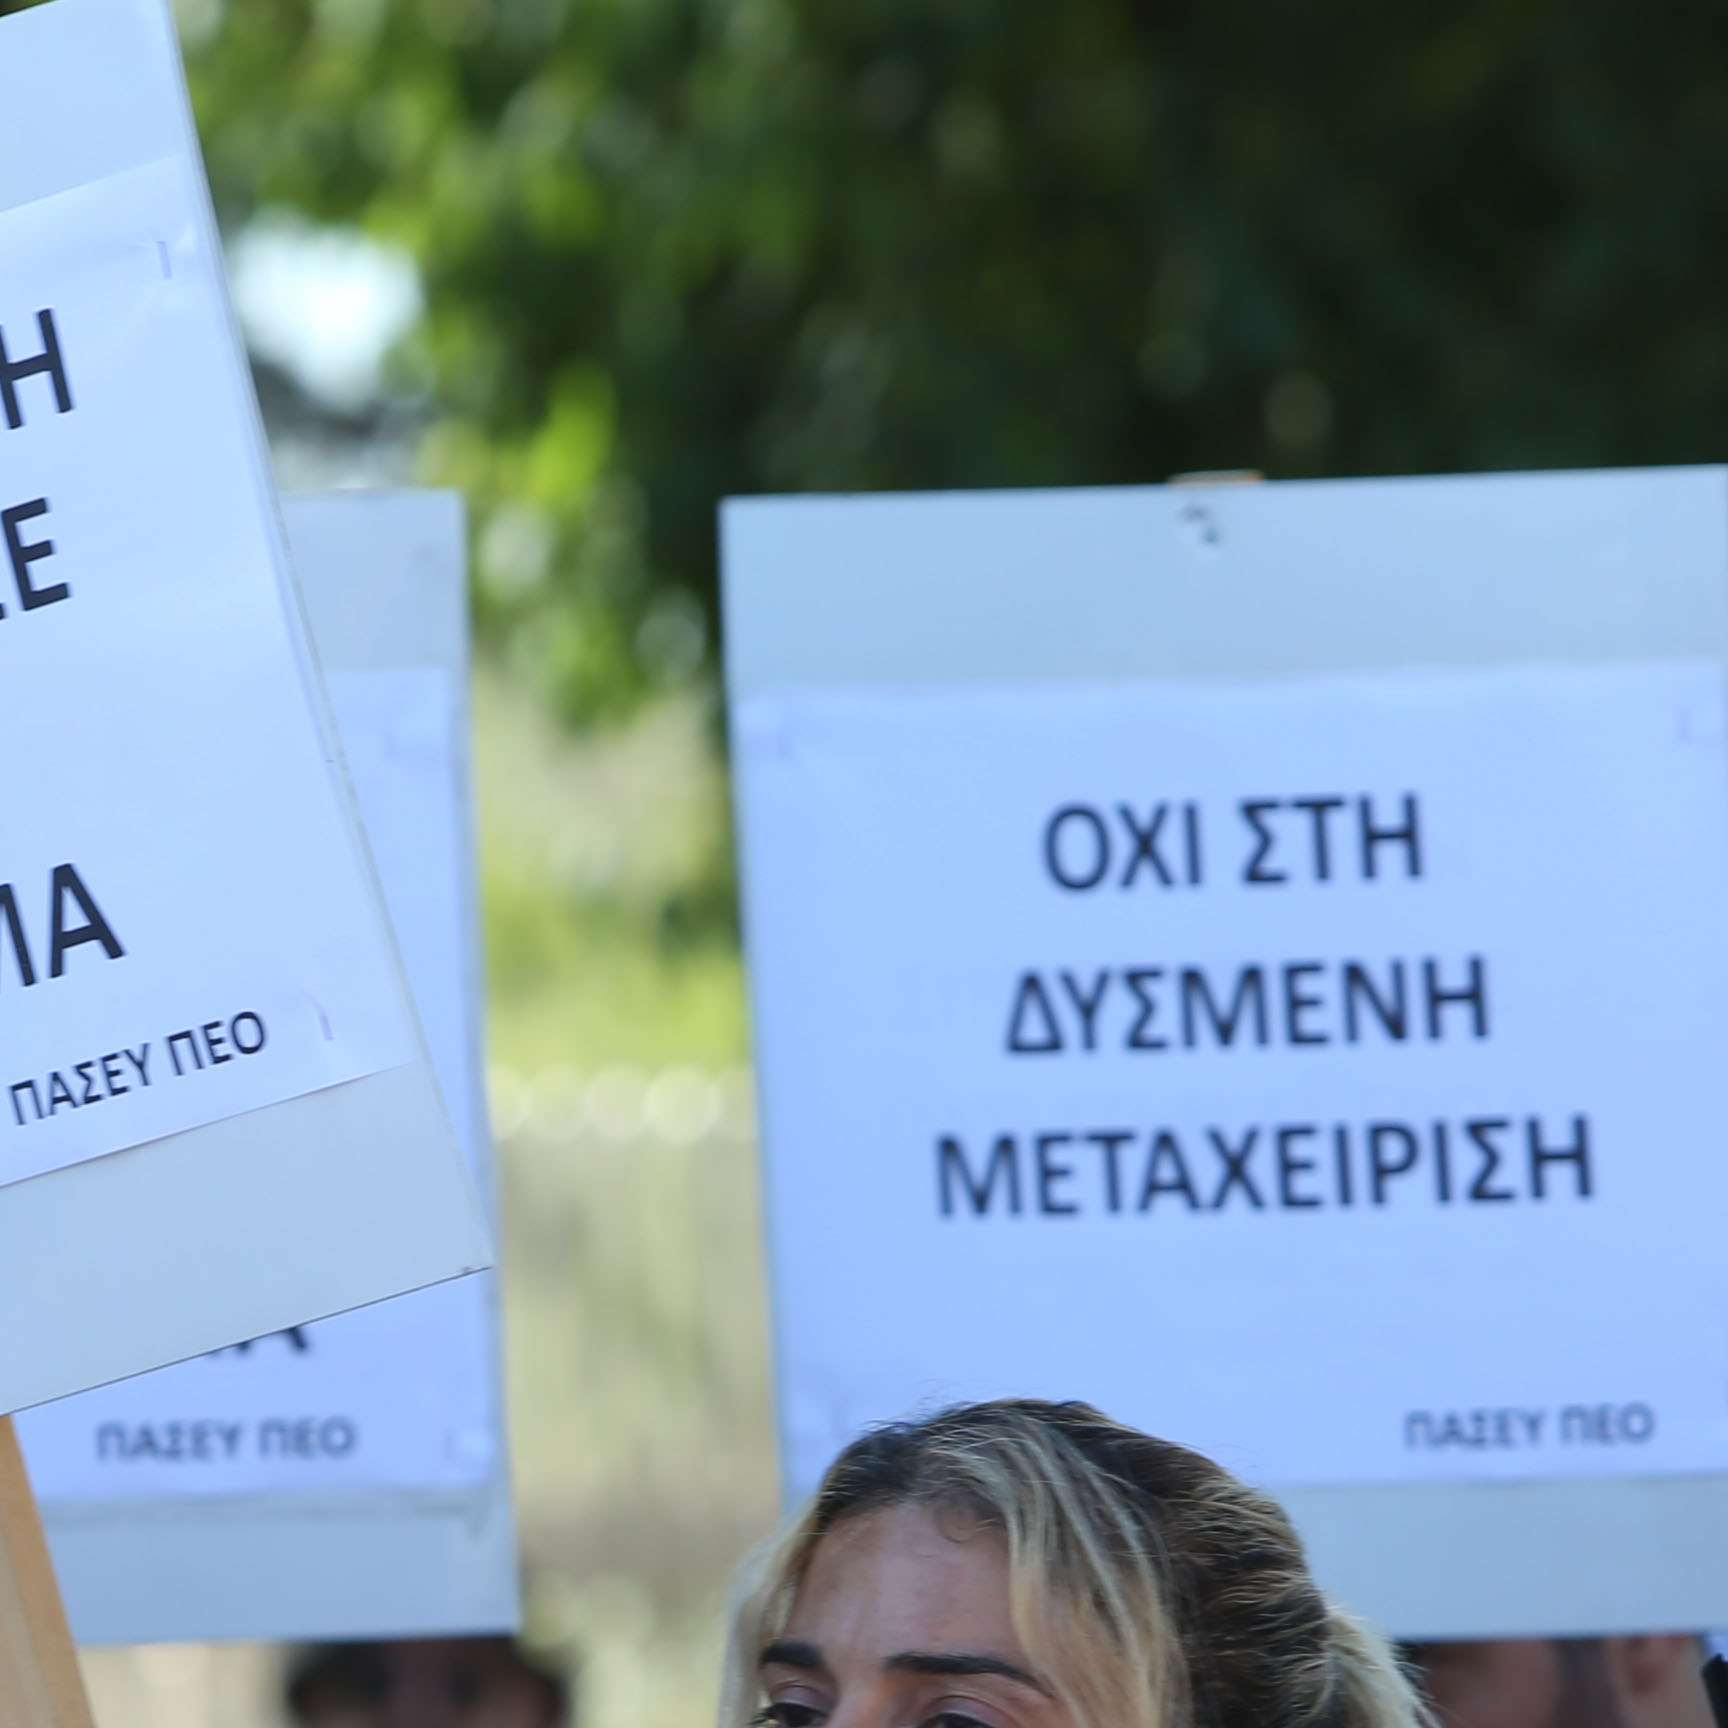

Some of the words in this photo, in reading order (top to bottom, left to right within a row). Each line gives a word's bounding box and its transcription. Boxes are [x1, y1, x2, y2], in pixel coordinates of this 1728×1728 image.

[1042, 802, 1205, 893] ΟΧΙ
[1237, 794, 1425, 887] ΣΤΗ
[1005, 955, 1492, 1057] ΔΥΣΜΕΝΗ
[8, 1041, 153, 1127] ΠΑΣΕΥ
[165, 1009, 268, 1078] ΠΕΟ
[935, 1114, 1595, 1218] ΜΕΤΑΧΕΙΡΙΣΗ
[94, 1419, 246, 1464] ΠΑΣΕΥ
[256, 1415, 359, 1461] ΠΕΟ
[1403, 1407, 1549, 1452] ΠΑΣΕΥ
[1557, 1401, 1658, 1447] ΠΕΟ
